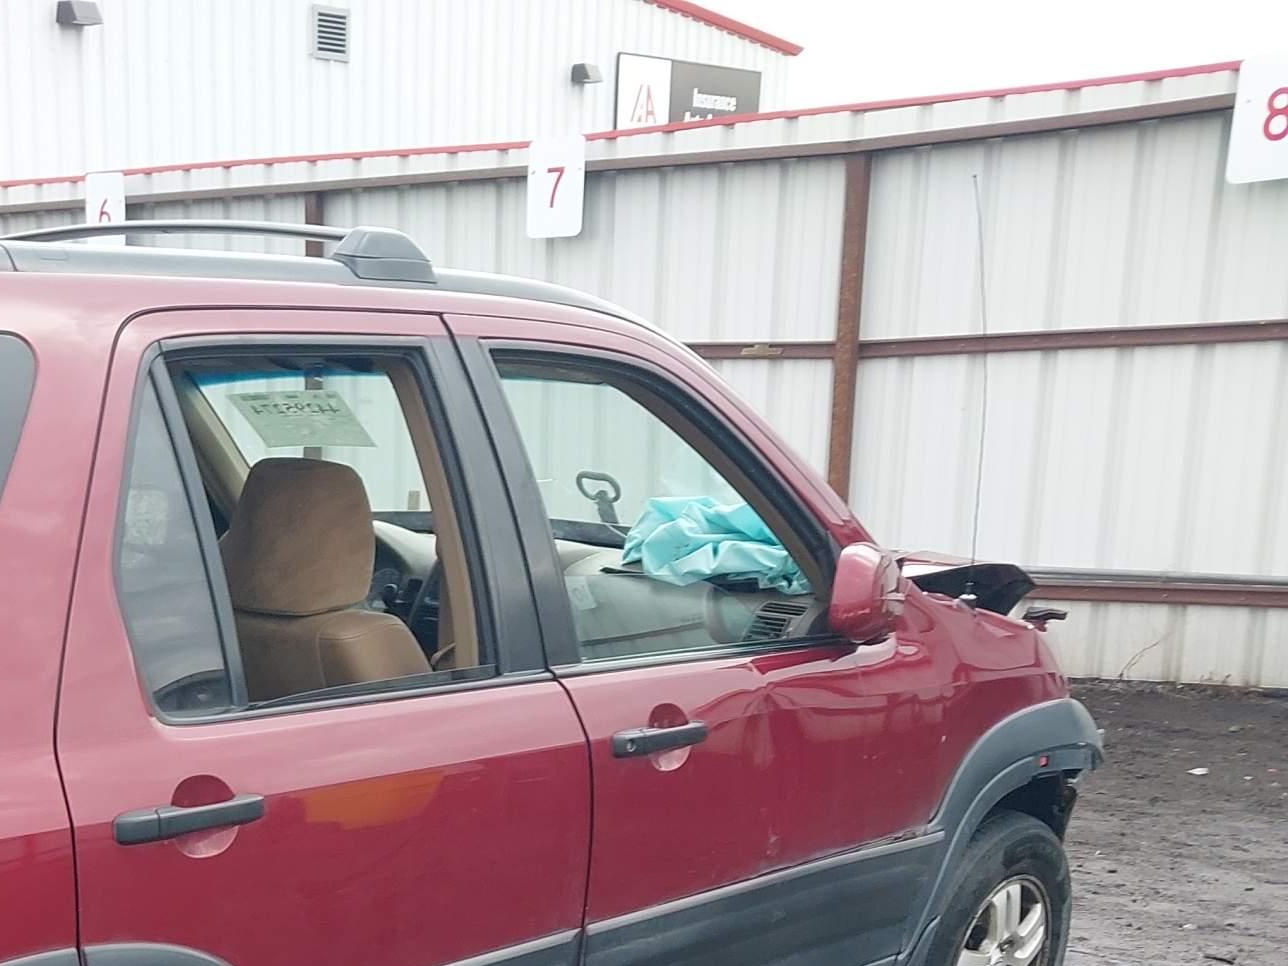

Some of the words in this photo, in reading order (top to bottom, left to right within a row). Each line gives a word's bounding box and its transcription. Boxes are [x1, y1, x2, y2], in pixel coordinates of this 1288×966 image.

[1262, 87, 1288, 141] 8
[546, 166, 566, 209] 7
[98, 198, 112, 224] 6
